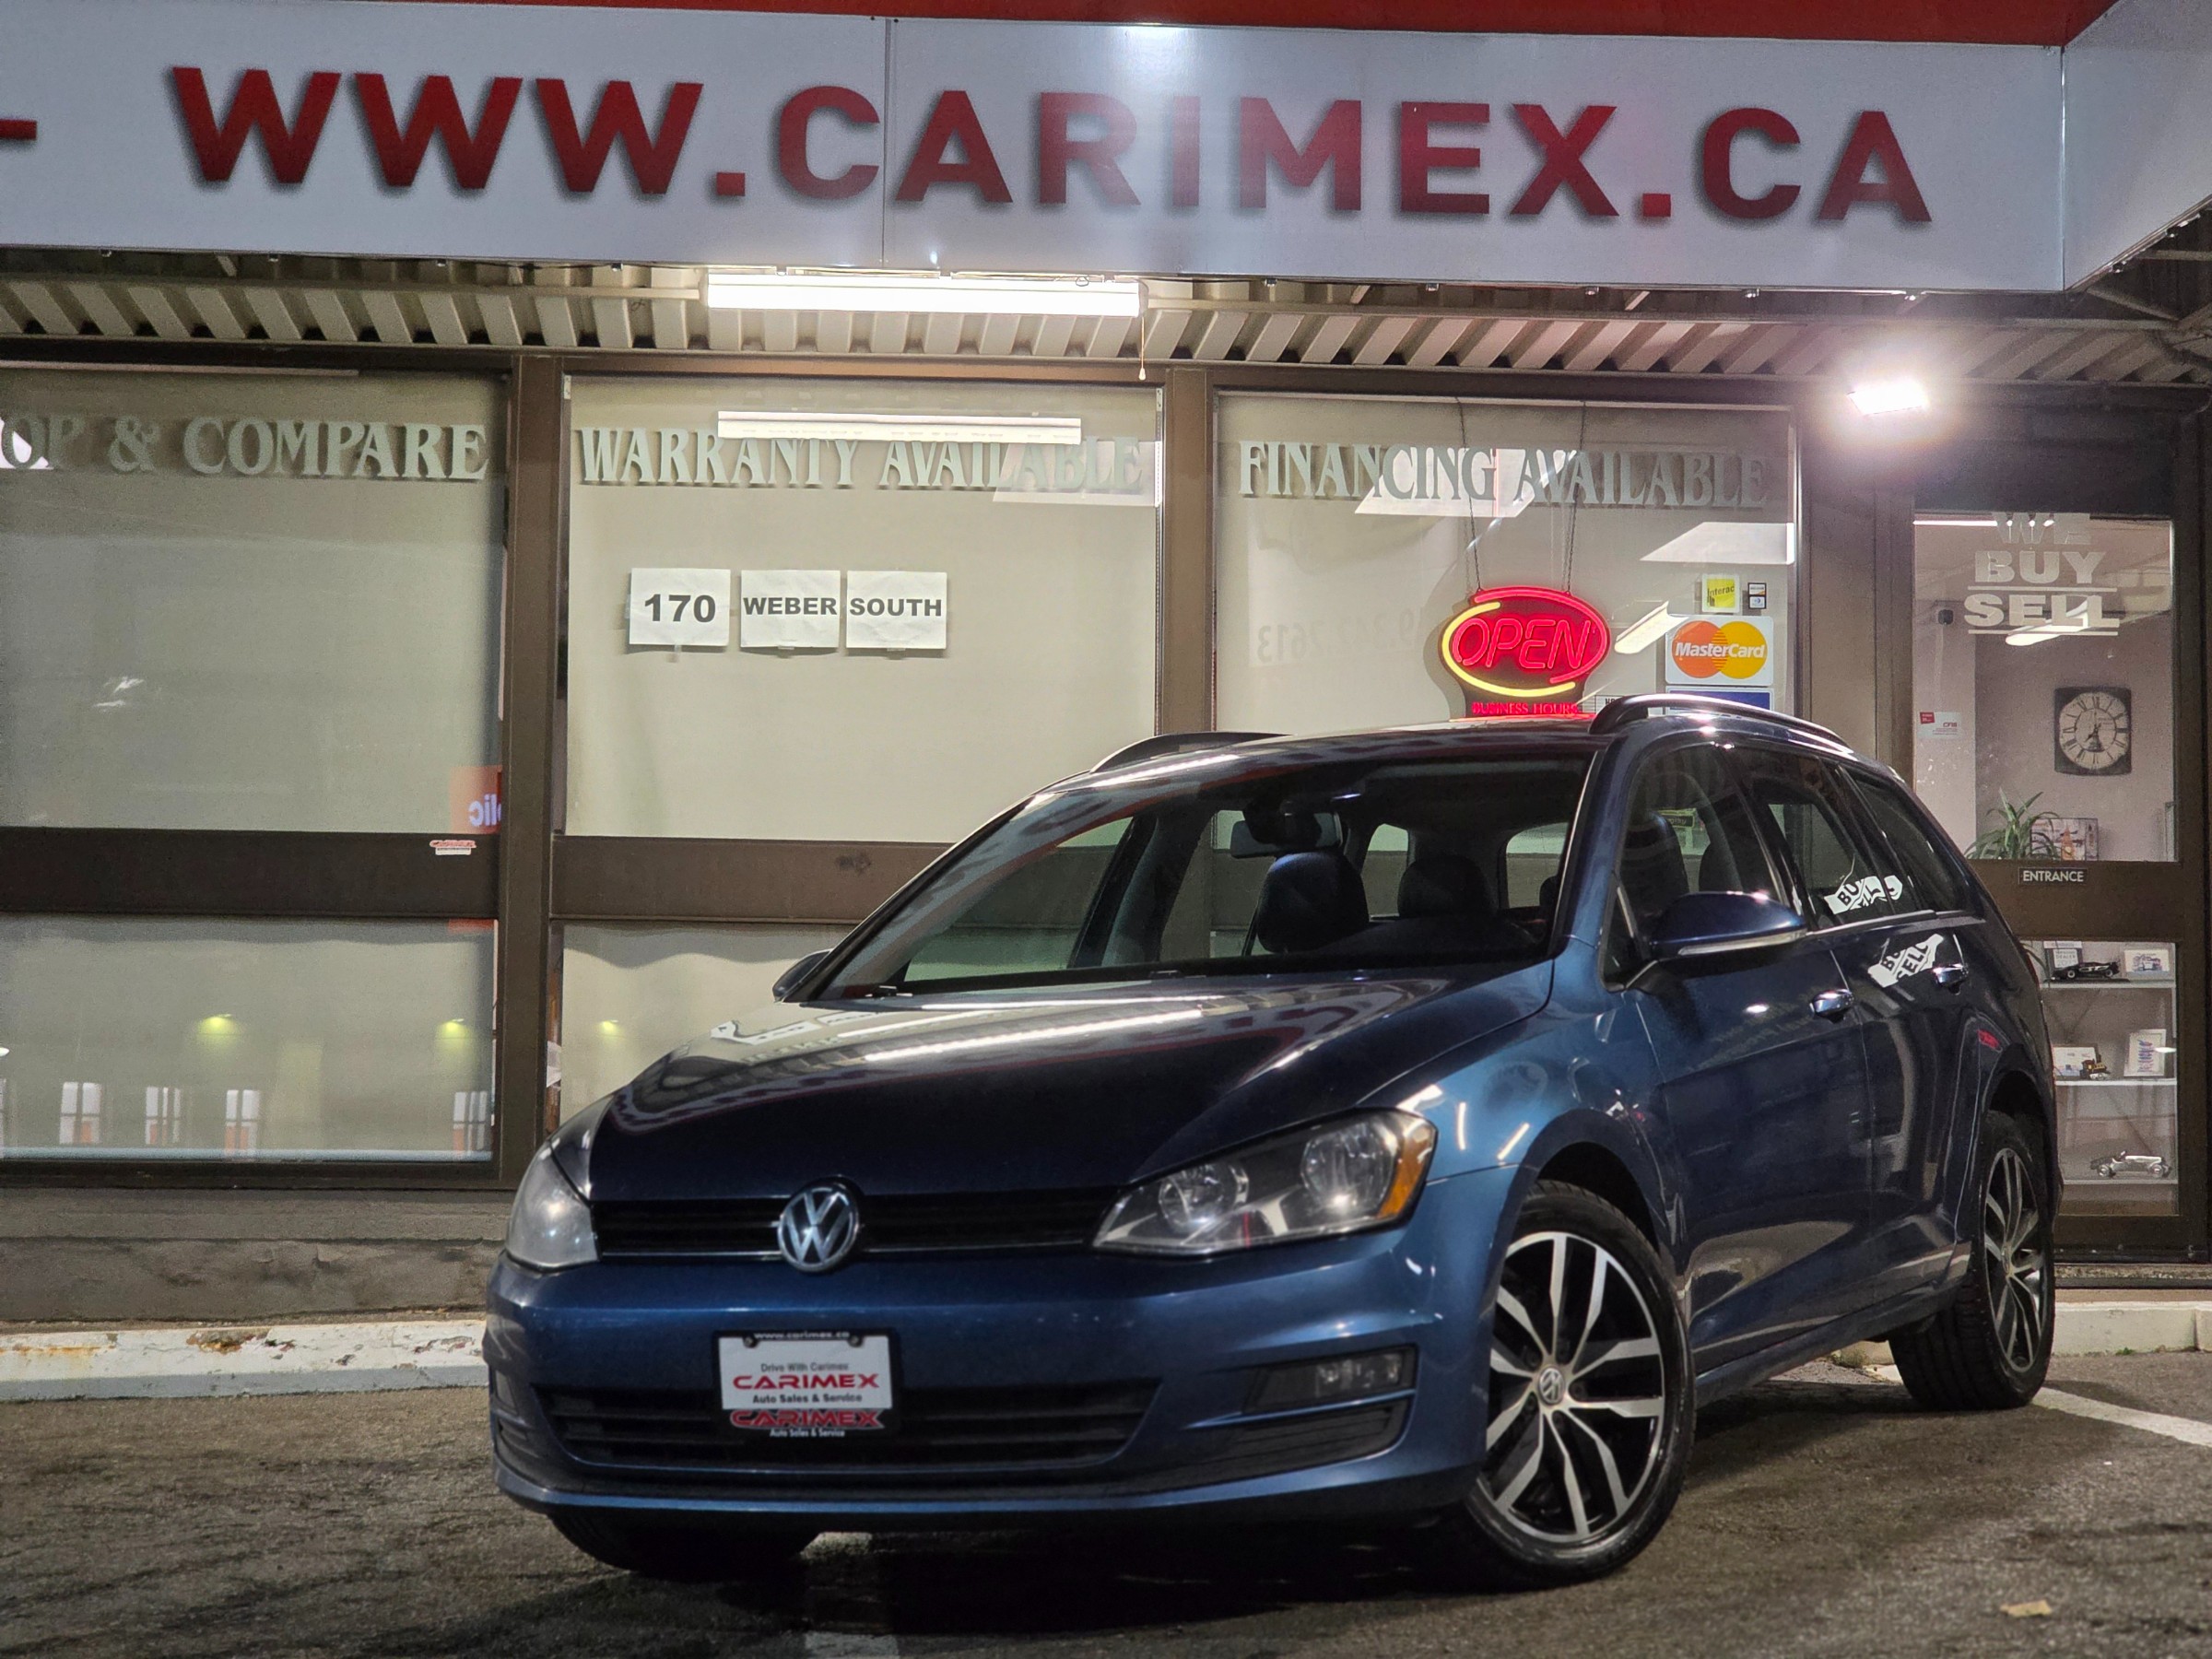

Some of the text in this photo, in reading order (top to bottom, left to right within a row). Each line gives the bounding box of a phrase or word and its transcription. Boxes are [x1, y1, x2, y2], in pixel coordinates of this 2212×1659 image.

[171, 67, 1933, 223] WWW.CARIMEX.CA
[109, 416, 157, 472] &
[183, 418, 490, 480] COMPARE
[581, 427, 1144, 490] WARRANTY AVAILABLE
[1239, 440, 1767, 506] FINANCING AVAILABLE
[1974, 550, 2107, 584] BUY
[1707, 585, 1735, 598] Interac
[644, 594, 942, 623] 170 WEBER SOUTH
[1964, 593, 2120, 628] SELL
[1452, 618, 1591, 669] OPEN
[1675, 642, 1765, 658] MasterCard
[1472, 702, 1578, 715] BUSINESS HOURS
[2022, 870, 2084, 882] ENTRANCE
[760, 1363, 784, 1372] Drive
[733, 1373, 880, 1390] CARIMEX
[753, 1393, 862, 1404] Auto Sales & Service
[731, 1409, 880, 1428] CARIMEX
[770, 1430, 788, 1438] Auto
[790, 1430, 808, 1438] Sales
[818, 1429, 845, 1437] Service
